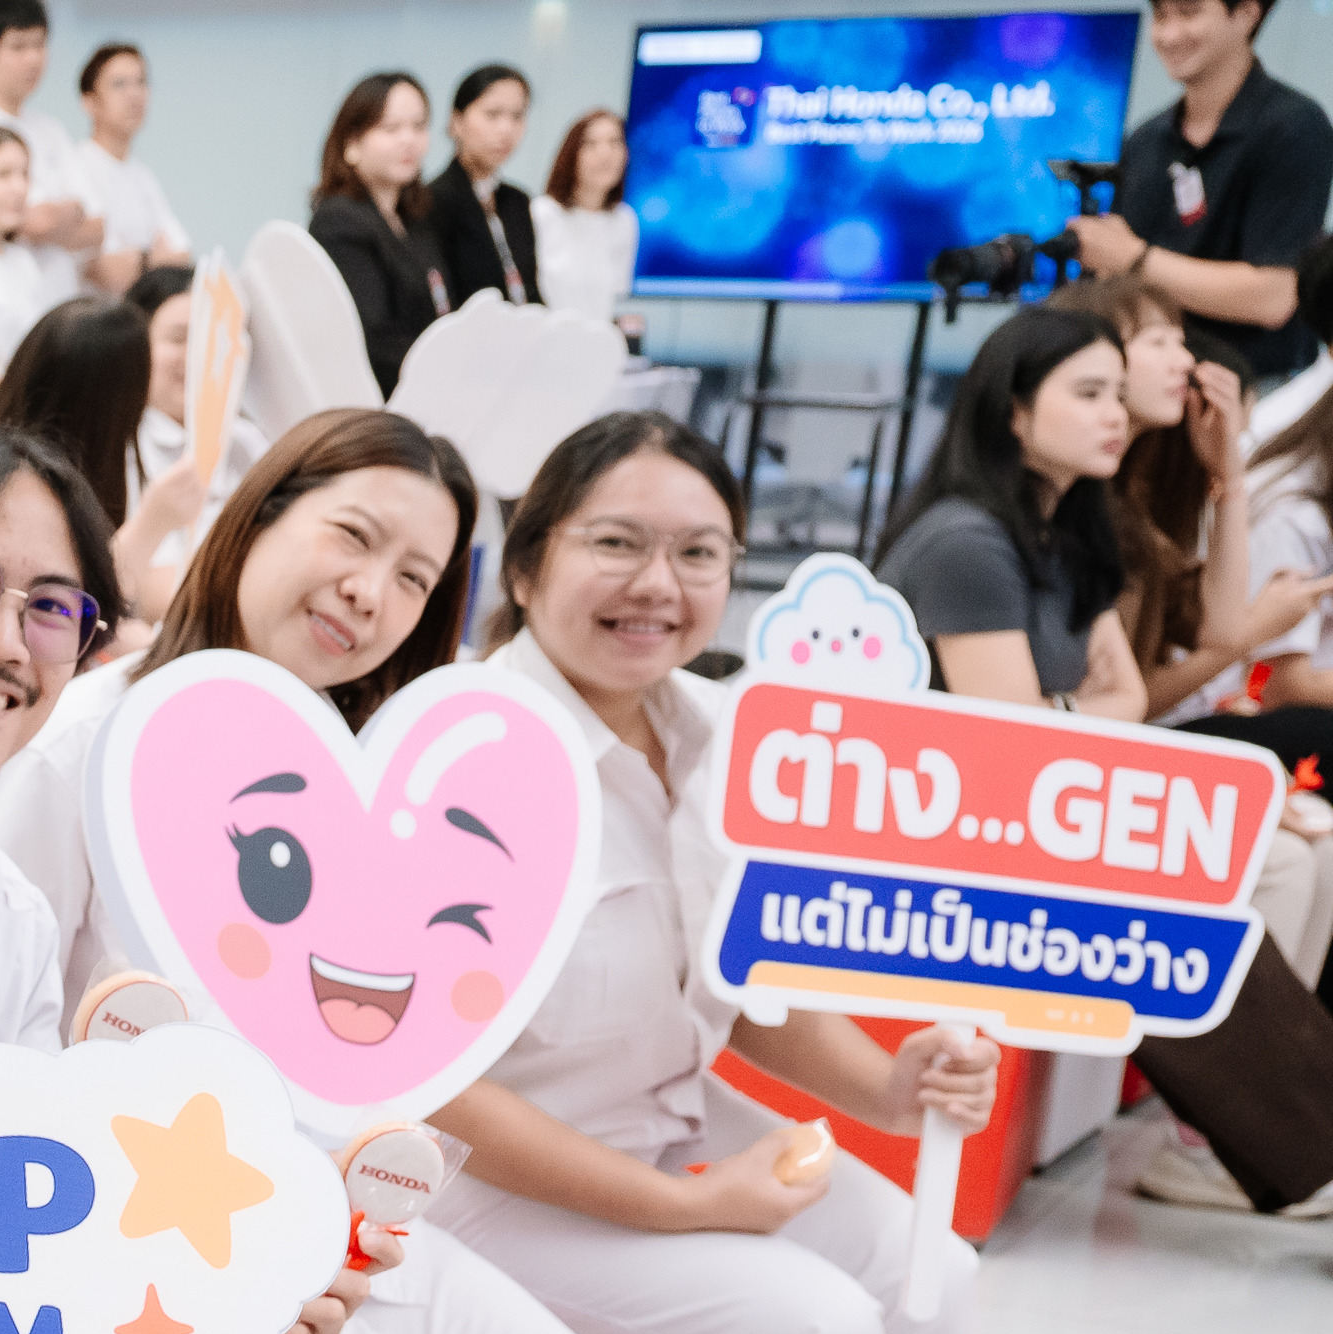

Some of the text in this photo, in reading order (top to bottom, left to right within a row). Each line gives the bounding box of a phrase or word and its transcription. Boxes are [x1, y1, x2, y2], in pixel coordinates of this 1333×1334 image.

[759, 880, 1210, 995] แต่ไม่เป็นช่องว่าง
[102, 1012, 146, 1037] HON
[359, 1164, 431, 1194] HONDA
